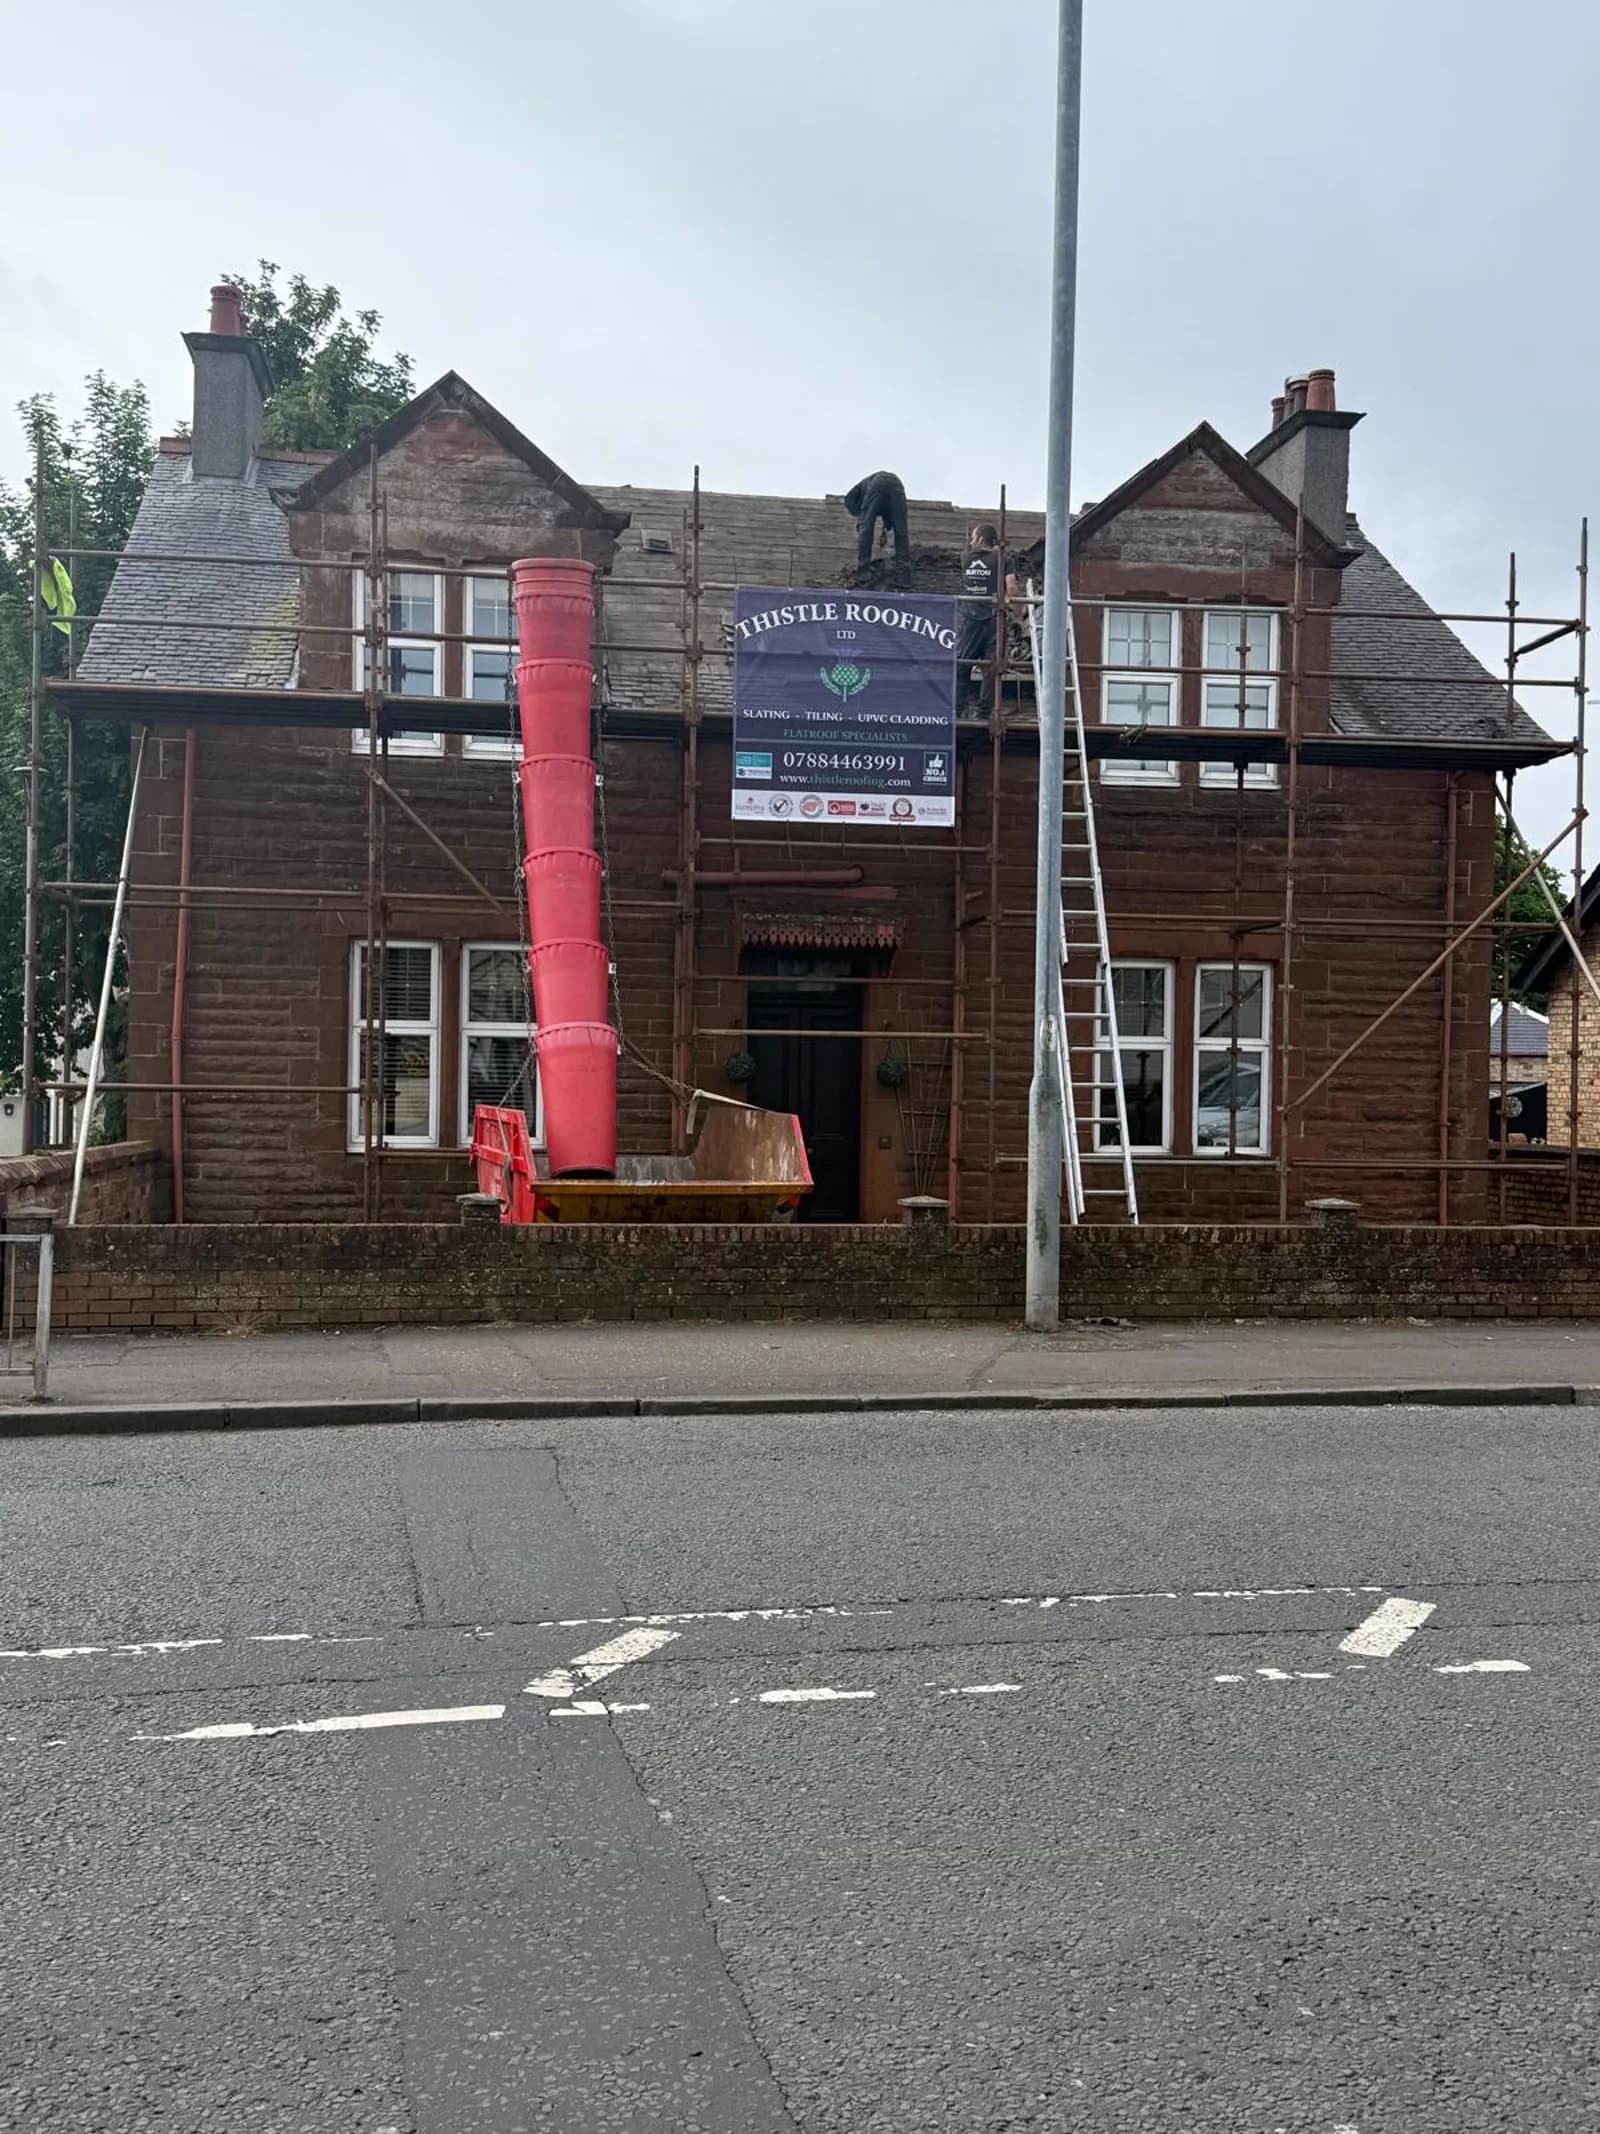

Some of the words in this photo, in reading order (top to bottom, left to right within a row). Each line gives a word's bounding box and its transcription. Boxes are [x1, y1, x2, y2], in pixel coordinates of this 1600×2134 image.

[735, 603, 838, 640] THISTLE
[845, 603, 957, 649] ROOFING
[836, 630, 856, 640] LTD
[742, 709, 791, 720] SLATING
[805, 711, 844, 722] TILING
[857, 713, 887, 724] UPVC
[889, 715, 949, 726] CLADDING
[842, 731, 909, 742] SPECIALISTS
[783, 751, 905, 772] 07884463991
[779, 774, 912, 788] www.thistleroofing.com
